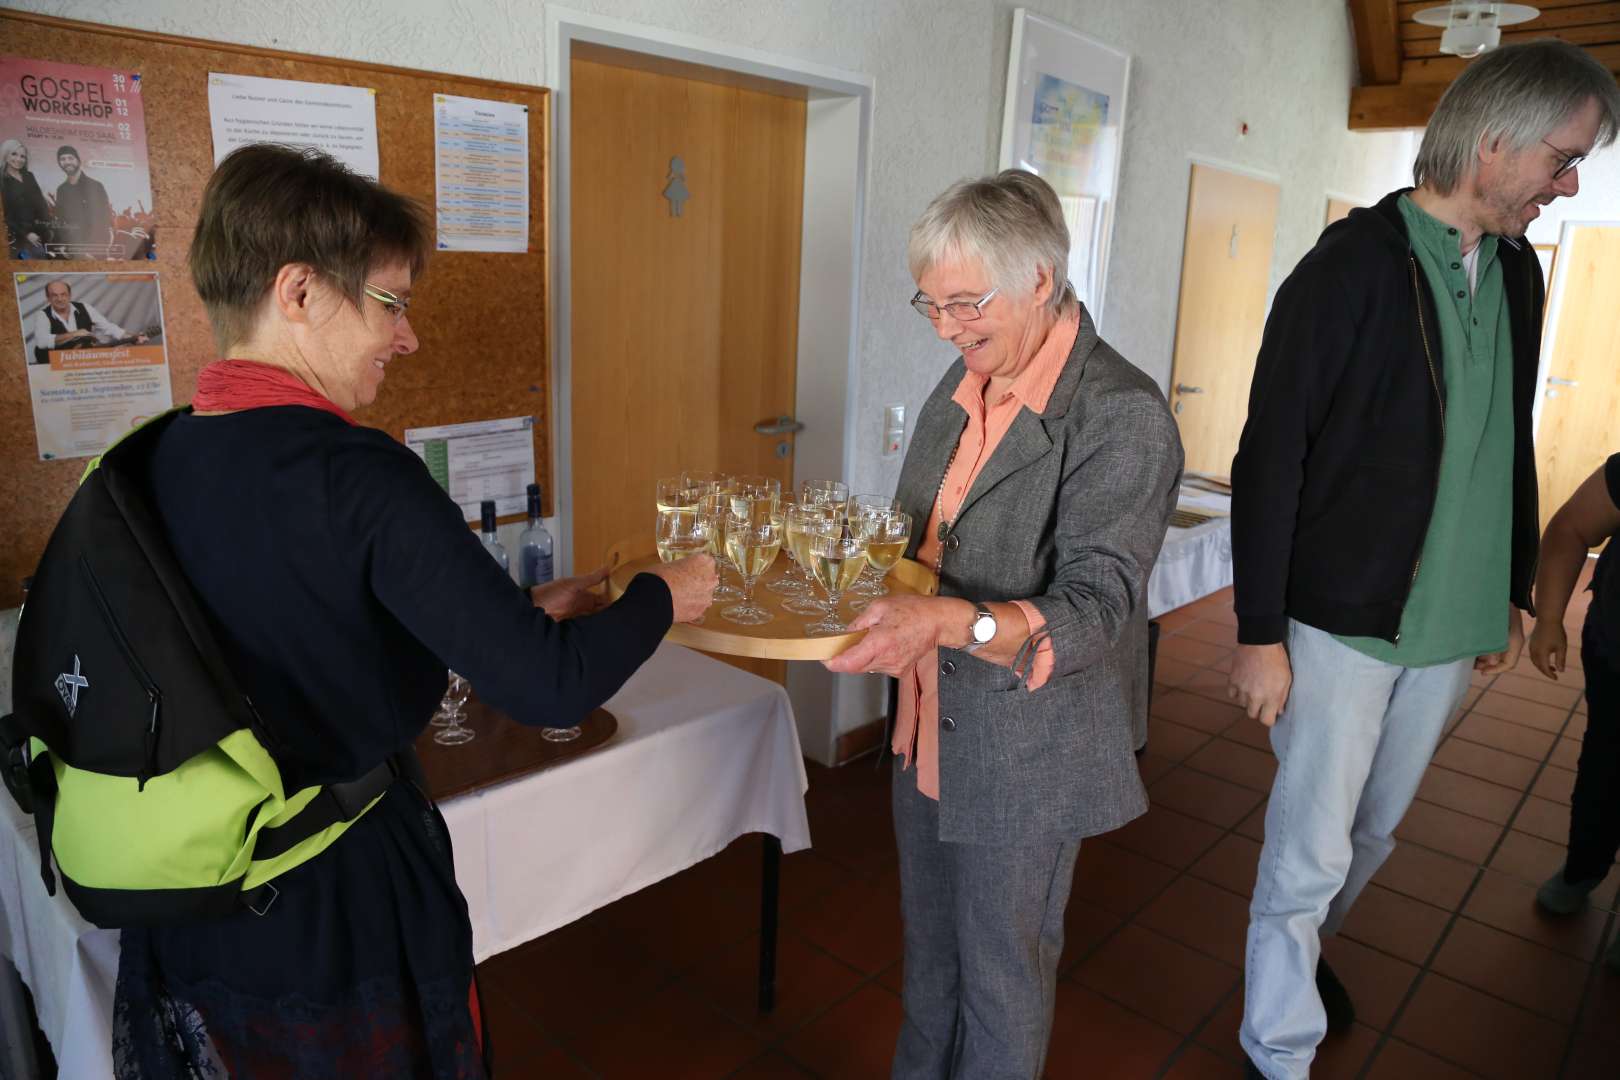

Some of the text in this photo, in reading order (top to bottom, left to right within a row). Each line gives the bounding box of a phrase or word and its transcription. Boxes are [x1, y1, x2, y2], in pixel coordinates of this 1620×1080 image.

[112, 74, 126, 84] 30
[20, 75, 112, 105] GOSPEL
[114, 83, 125, 92] 11
[22, 97, 113, 119] WORKSHOP
[116, 108, 128, 116] 12
